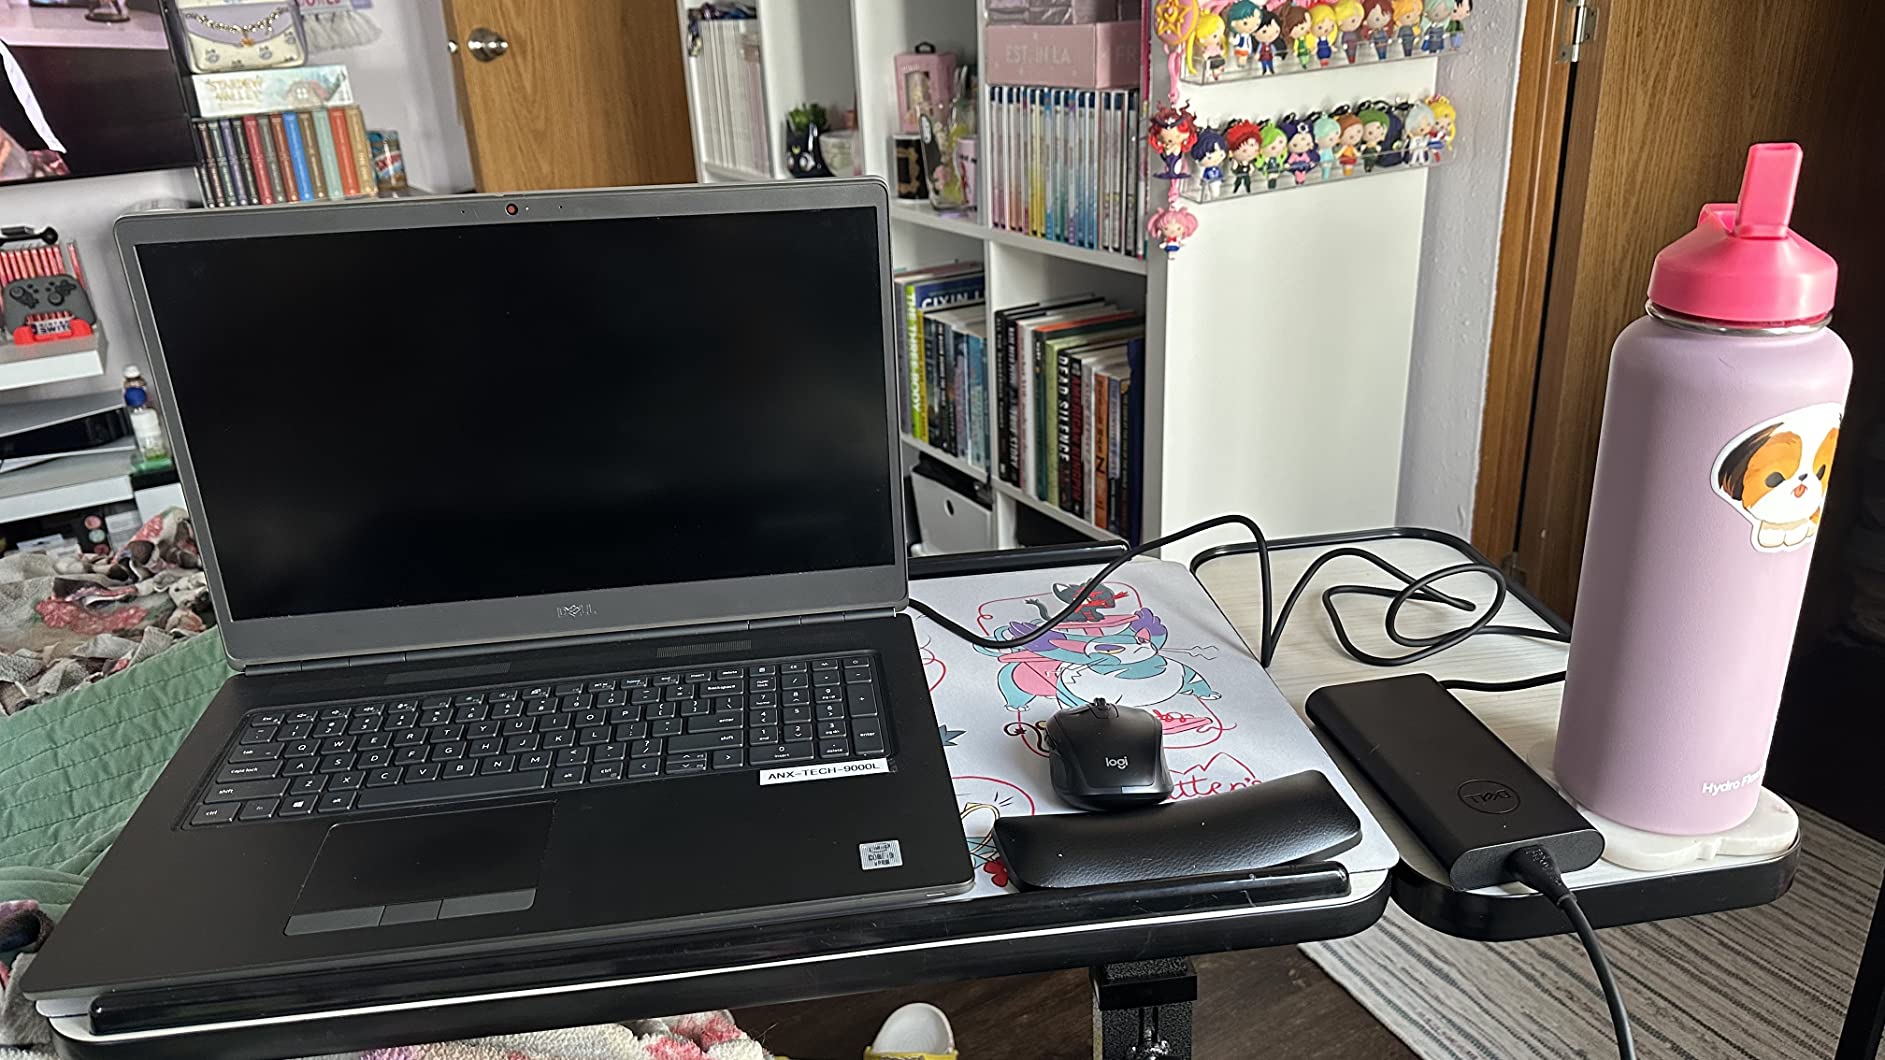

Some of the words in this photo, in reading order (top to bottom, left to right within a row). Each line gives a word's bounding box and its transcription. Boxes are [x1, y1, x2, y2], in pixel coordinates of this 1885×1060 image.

[1052, 47, 1071, 64] LA
[40, 324, 70, 334] SWIT
[1058, 355, 1070, 396] DEAD
[1058, 400, 1070, 462] SILENCE
[1105, 756, 1128, 769] logi
[768, 763, 880, 780] ANX-TECH-9000L
[1702, 780, 1740, 796] Hydro
